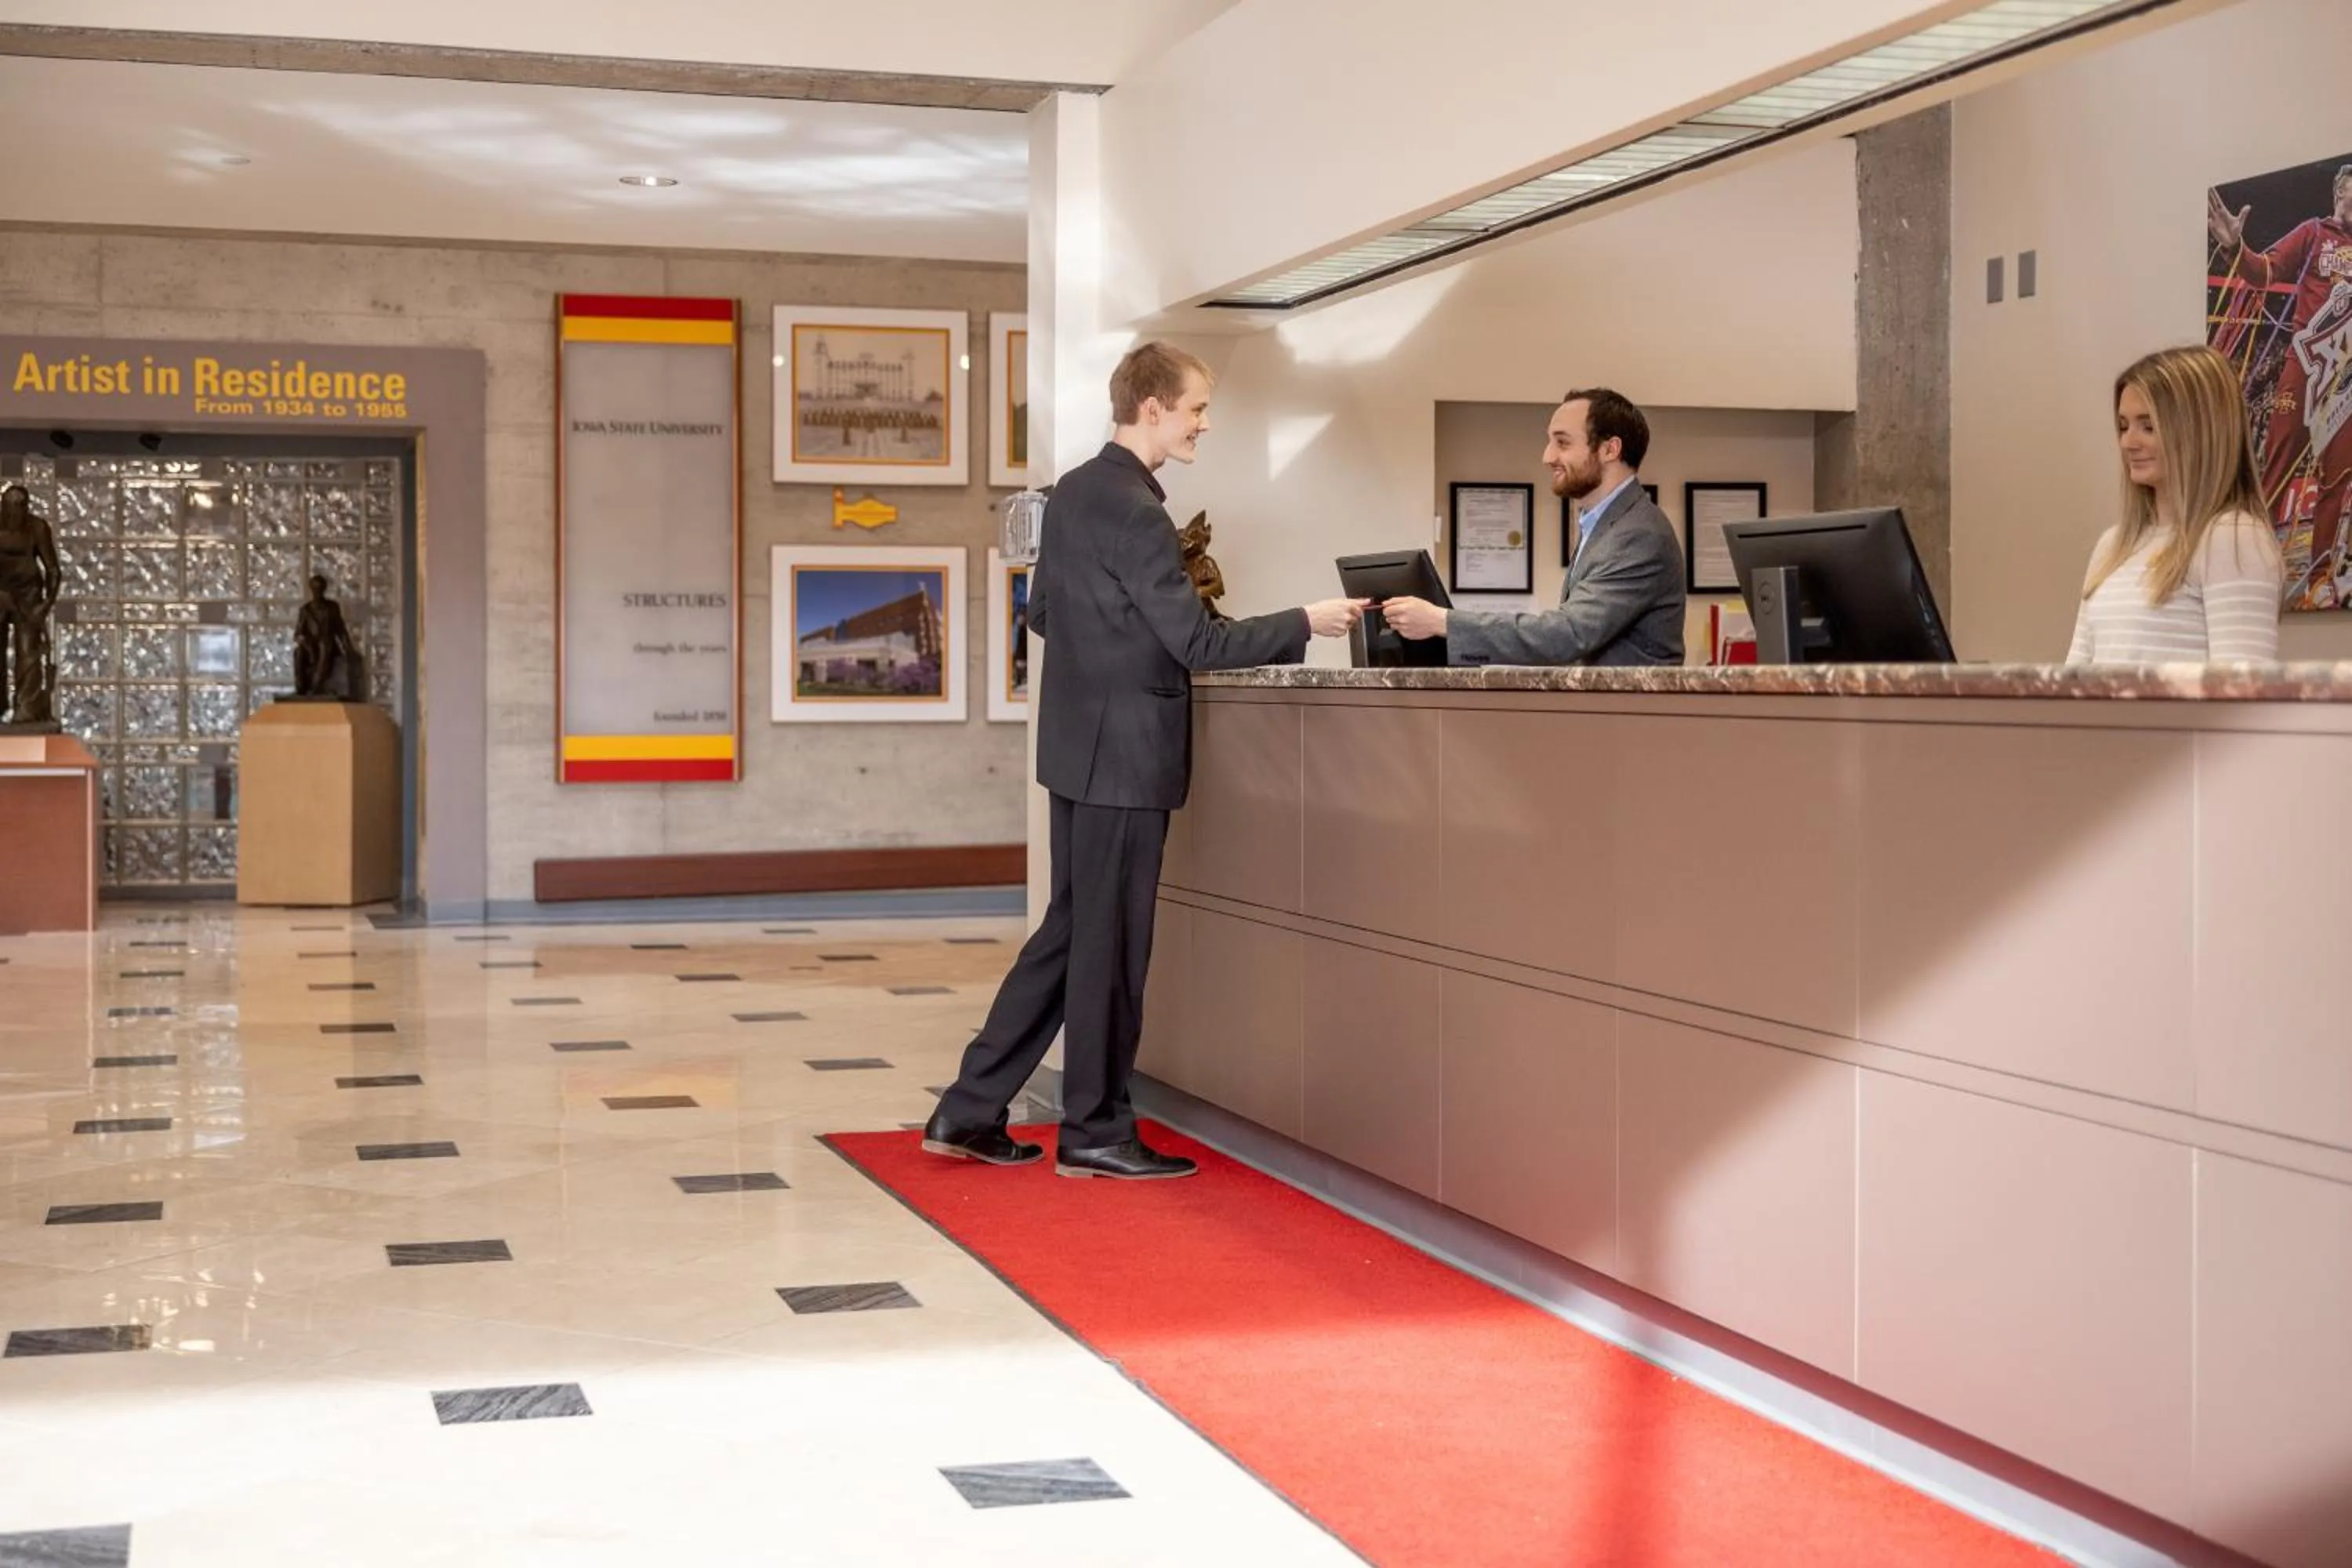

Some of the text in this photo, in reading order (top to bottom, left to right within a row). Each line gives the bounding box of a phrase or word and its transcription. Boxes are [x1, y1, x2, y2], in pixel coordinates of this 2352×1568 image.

[13, 351, 406, 401] Artist in Residence
[194, 397, 254, 415] From
[263, 400, 315, 416] 1934
[322, 401, 347, 417] to
[622, 592, 727, 608] STRUCTURES
[633, 641, 674, 655] through
[677, 641, 695, 653] the
